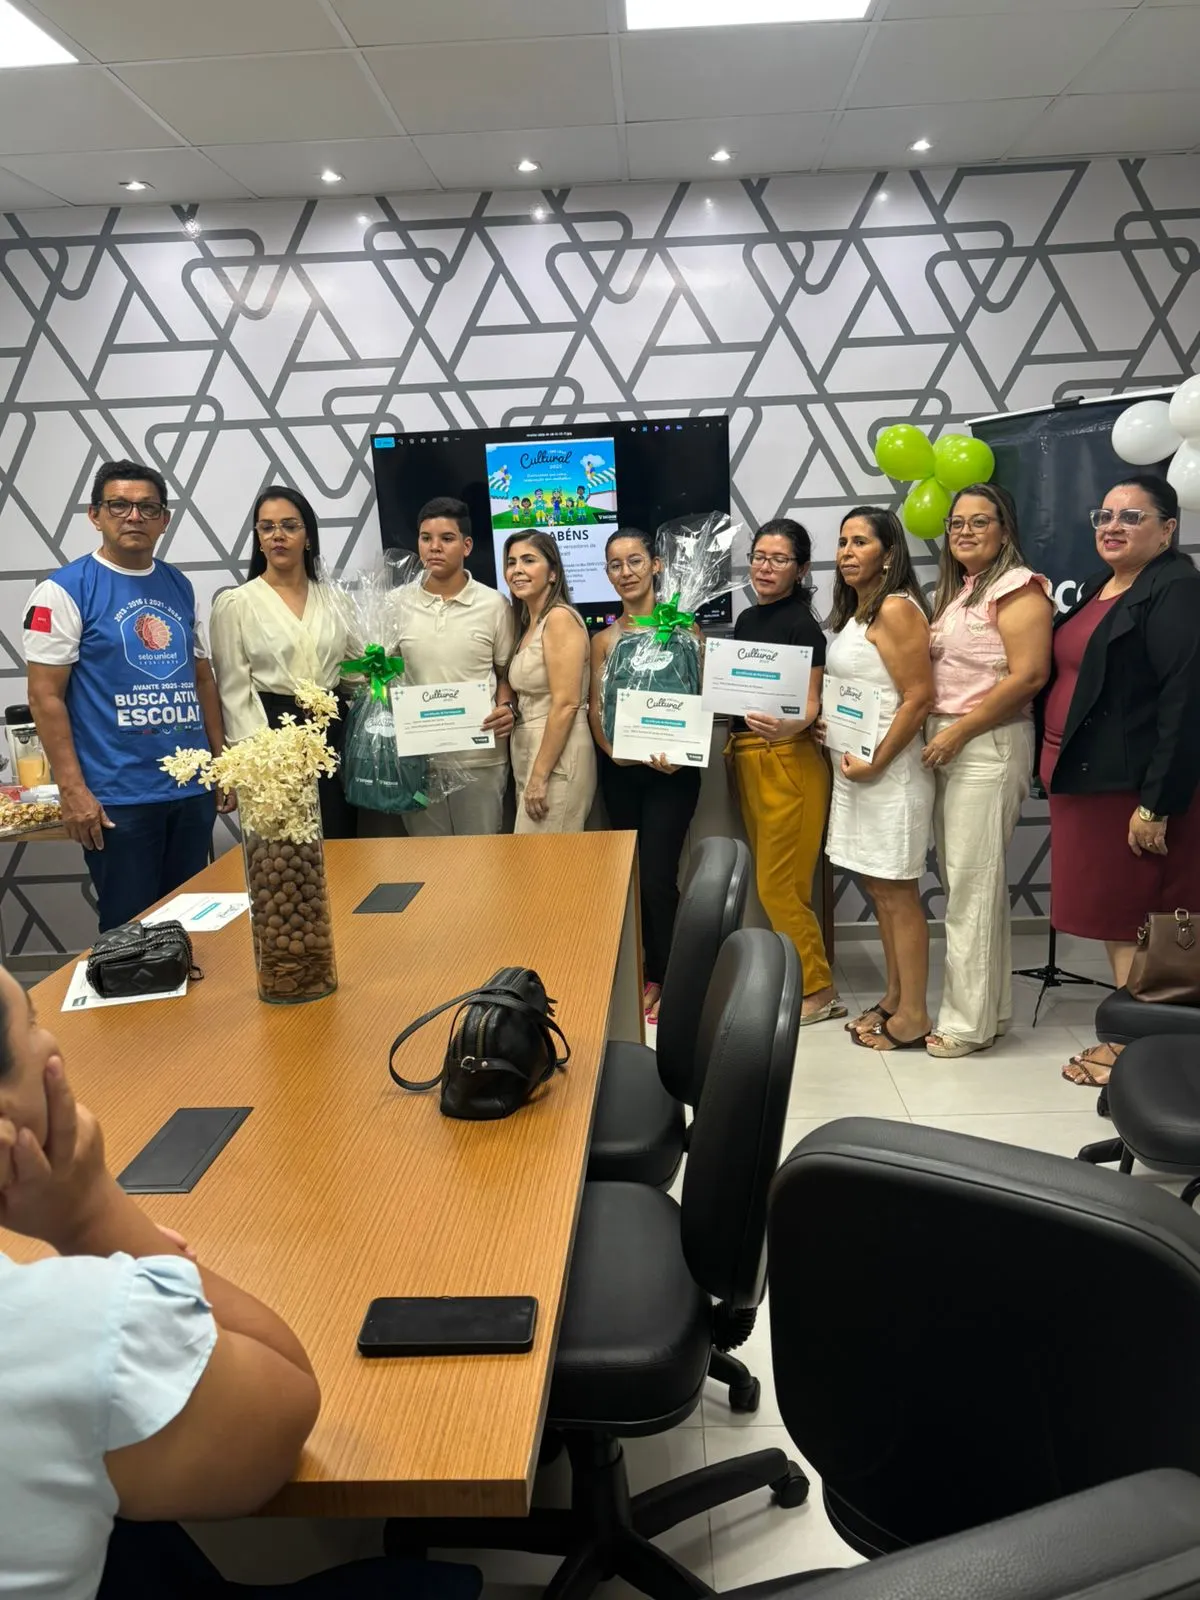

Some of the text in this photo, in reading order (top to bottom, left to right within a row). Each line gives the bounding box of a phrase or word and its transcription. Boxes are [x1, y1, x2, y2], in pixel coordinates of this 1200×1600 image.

[520, 450, 572, 469] Cultural
[549, 528, 590, 541] ABÉNS
[153, 651, 177, 660] unicef
[737, 647, 779, 662] Cultural
[132, 683, 160, 691] AVANTE
[114, 691, 198, 707] BUSCA ATIV
[421, 689, 460, 702] Cultural
[646, 697, 684, 711] Cultural
